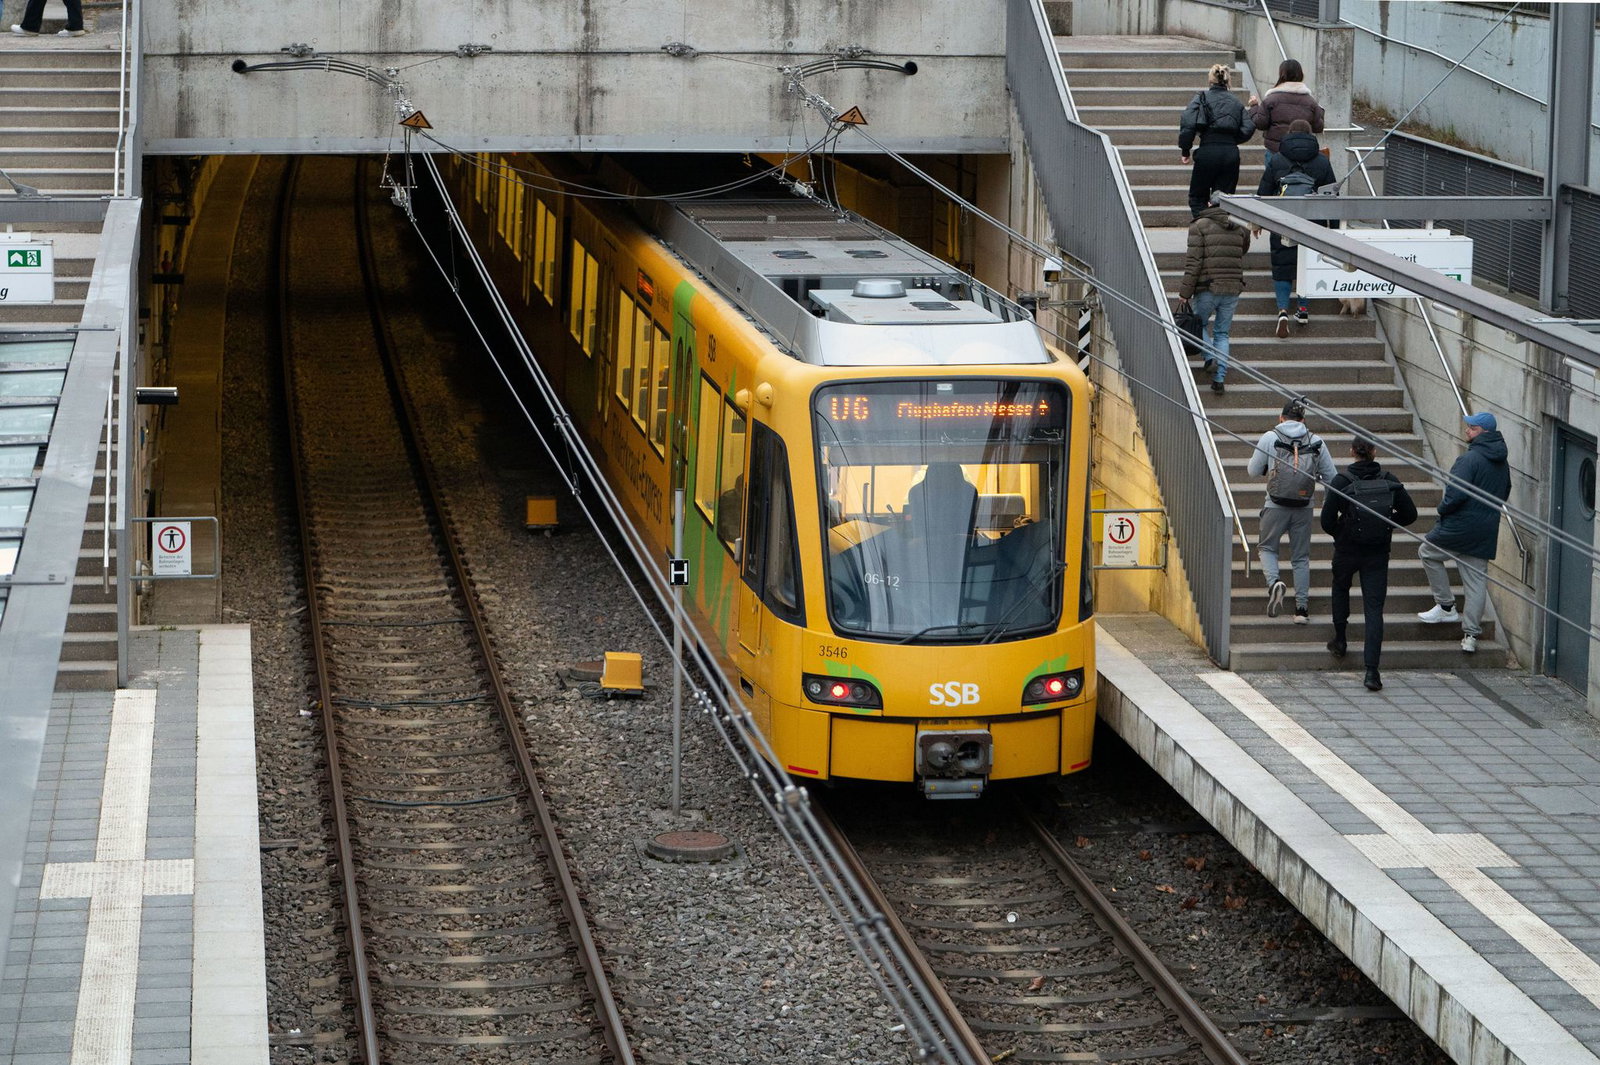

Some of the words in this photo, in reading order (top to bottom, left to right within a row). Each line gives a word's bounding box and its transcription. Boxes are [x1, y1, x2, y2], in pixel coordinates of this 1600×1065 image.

[1332, 279, 1396, 295] Laubeweg
[831, 396, 869, 420] U6
[671, 563, 688, 583] H
[864, 572, 900, 588] 06-12
[818, 644, 848, 659] 3546
[929, 681, 980, 707] SSB
